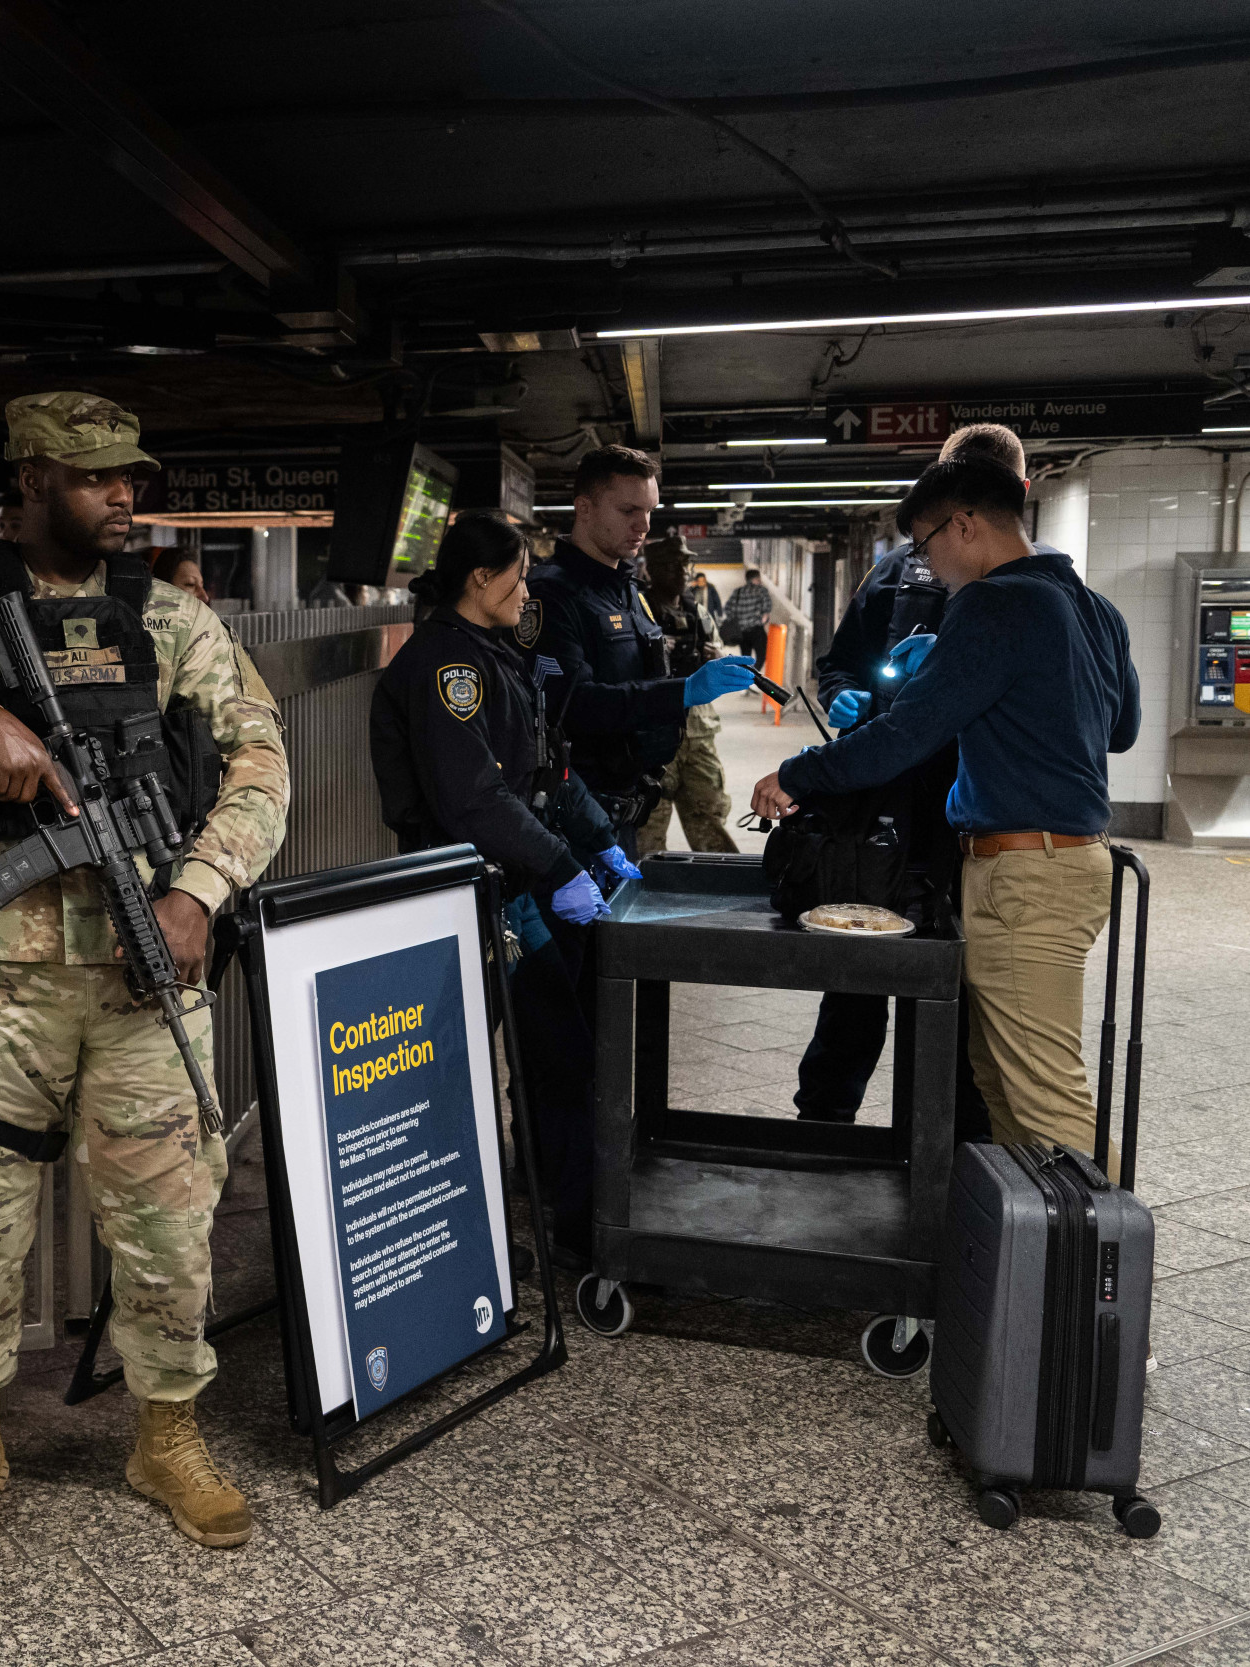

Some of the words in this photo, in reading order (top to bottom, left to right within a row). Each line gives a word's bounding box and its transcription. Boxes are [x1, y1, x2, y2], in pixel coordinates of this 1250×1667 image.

[870, 406, 939, 435] Exit
[951, 401, 1035, 418] Vanderbilt
[1043, 401, 1107, 416] Avenue
[1029, 419, 1060, 433] Ave
[134, 479, 149, 504] 7
[167, 468, 217, 488] Main
[266, 466, 338, 487] Queen
[167, 491, 195, 511] 34
[205, 489, 326, 510] St-Hudson
[71, 651, 88, 662] ALI
[81, 667, 118, 681] ARMY
[443, 669, 478, 682] POLICE
[330, 1004, 424, 1054] Container
[332, 1040, 434, 1096] Inspection
[337, 1113, 400, 1143] Backpacks/containers
[401, 1110, 410, 1118] are
[410, 1100, 429, 1114] subject
[339, 1147, 345, 1156] to
[345, 1135, 375, 1153] inspection
[376, 1130, 388, 1143] prior
[390, 1127, 395, 1135] to
[396, 1118, 419, 1132] entering
[340, 1158, 349, 1169] the
[350, 1153, 365, 1164] Mass
[366, 1142, 385, 1157] Transit
[386, 1135, 408, 1150] System.
[342, 1174, 373, 1195] Individuals
[374, 1170, 386, 1180] may
[386, 1163, 403, 1175] refuse
[410, 1150, 428, 1165] permit
[343, 1189, 374, 1207] inspection
[374, 1182, 385, 1193] and
[386, 1176, 399, 1189] elect
[400, 1172, 409, 1183] not
[410, 1170, 416, 1178] to
[416, 1163, 430, 1176] enter
[431, 1160, 439, 1168] the
[440, 1151, 460, 1165] system.
[346, 1213, 377, 1233] Individuals
[378, 1206, 387, 1218] will
[387, 1203, 396, 1214] not
[397, 1201, 404, 1209] be
[405, 1186, 432, 1206] permitted
[432, 1180, 451, 1191] access
[347, 1237, 354, 1245] to
[355, 1232, 365, 1242] the
[365, 1223, 386, 1238] system
[386, 1216, 398, 1227] with
[399, 1213, 408, 1221] the
[408, 1195, 441, 1216] uninspected
[442, 1185, 468, 1201] container.
[350, 1250, 381, 1272] Individuals
[381, 1245, 394, 1255] who
[395, 1236, 412, 1250] refuse
[413, 1231, 422, 1240] the
[422, 1219, 448, 1236] container
[352, 1268, 372, 1284] search
[373, 1262, 384, 1273] and
[384, 1256, 396, 1269] later
[397, 1245, 419, 1262] attempt
[426, 1236, 440, 1248] enter
[441, 1231, 450, 1240] the
[353, 1281, 374, 1297] system
[375, 1275, 387, 1286] with
[388, 1270, 398, 1280] the
[398, 1250, 432, 1274] uninspected
[433, 1240, 458, 1257] container
[355, 1300, 368, 1310] may
[368, 1295, 376, 1303] be
[377, 1284, 398, 1298] subject
[398, 1279, 405, 1288] to
[405, 1270, 423, 1284] arrest.
[474, 1305, 491, 1328] MTA
